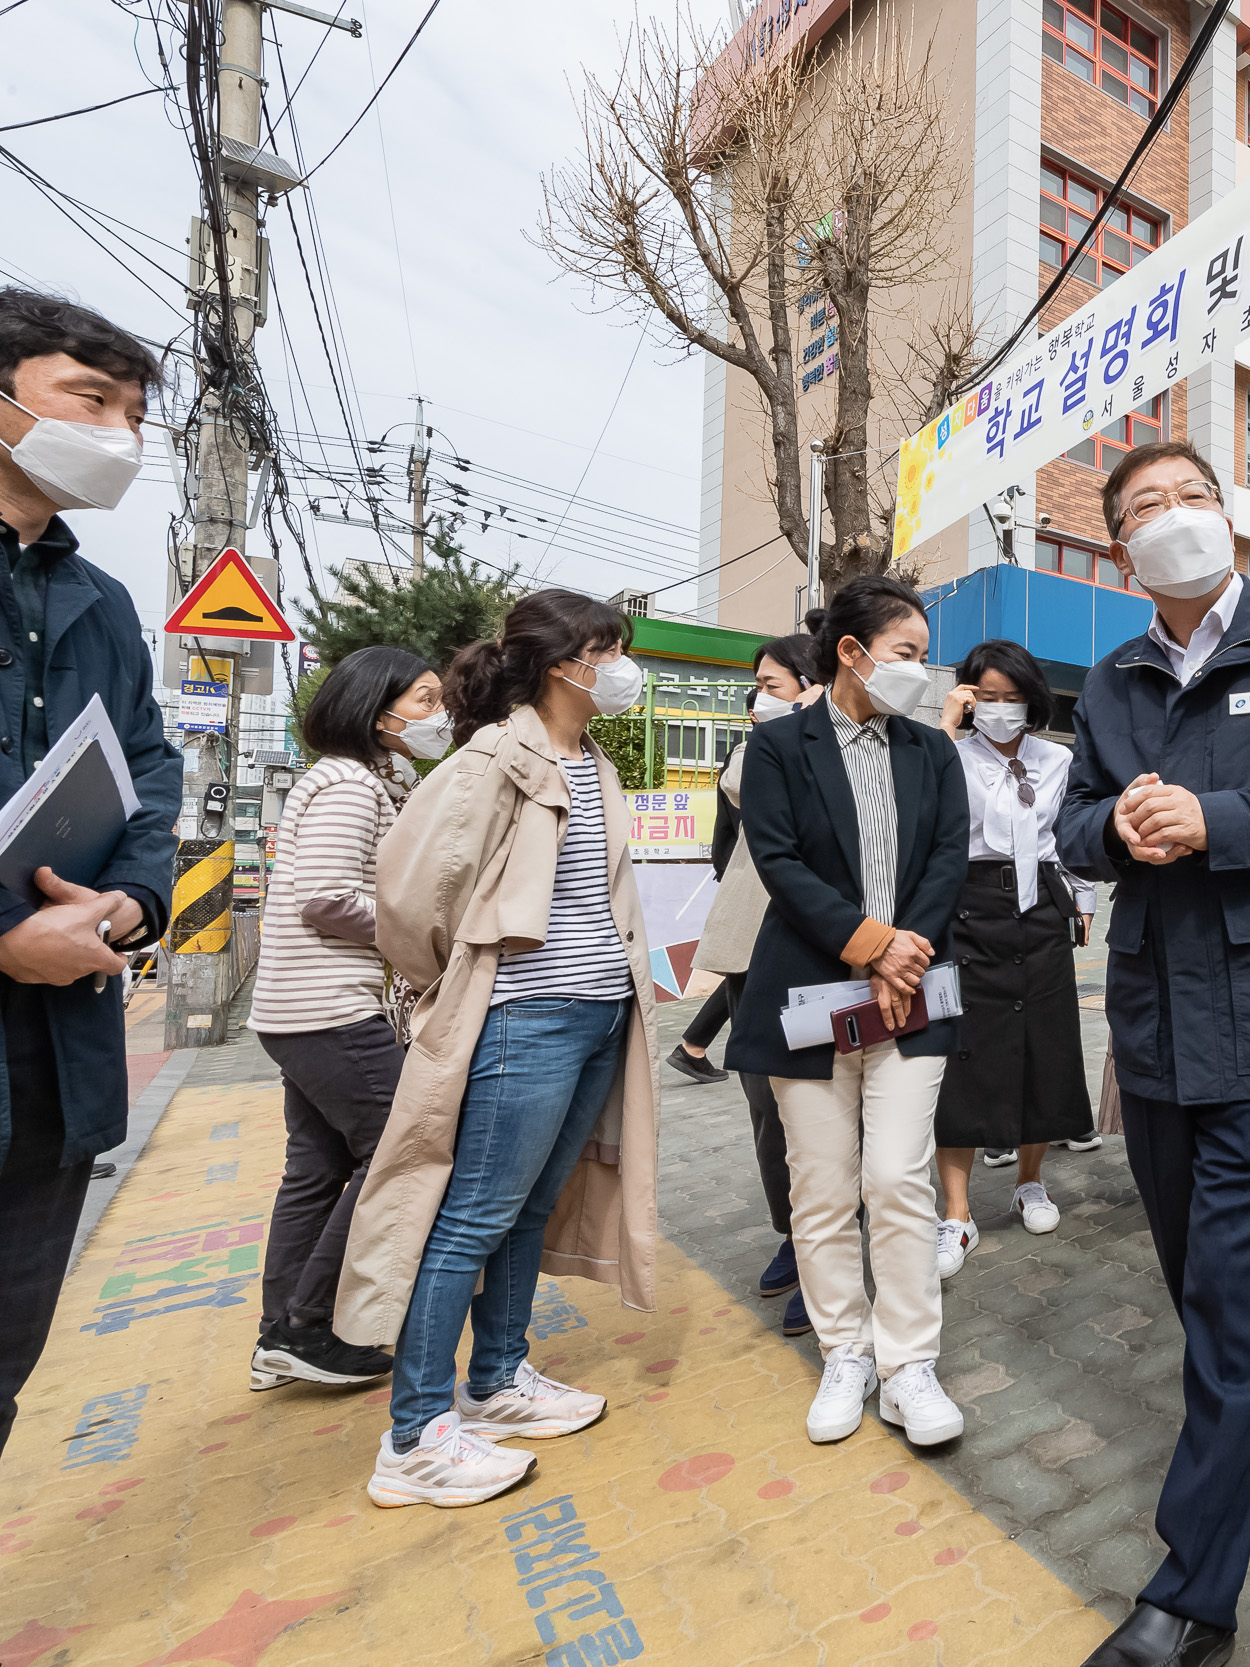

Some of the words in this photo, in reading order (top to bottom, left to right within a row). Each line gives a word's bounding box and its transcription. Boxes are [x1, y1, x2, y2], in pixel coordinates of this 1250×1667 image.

[939, 382, 1003, 443] 성자다움을
[1006, 355, 1043, 390] 키워가는
[1048, 313, 1095, 361] 행복학교
[985, 378, 1045, 458] 학교
[1060, 268, 1187, 415] 설명회
[1206, 235, 1244, 315] 및
[183, 684, 209, 694] 경고!
[634, 794, 667, 811] 정문
[674, 793, 690, 811] 앞
